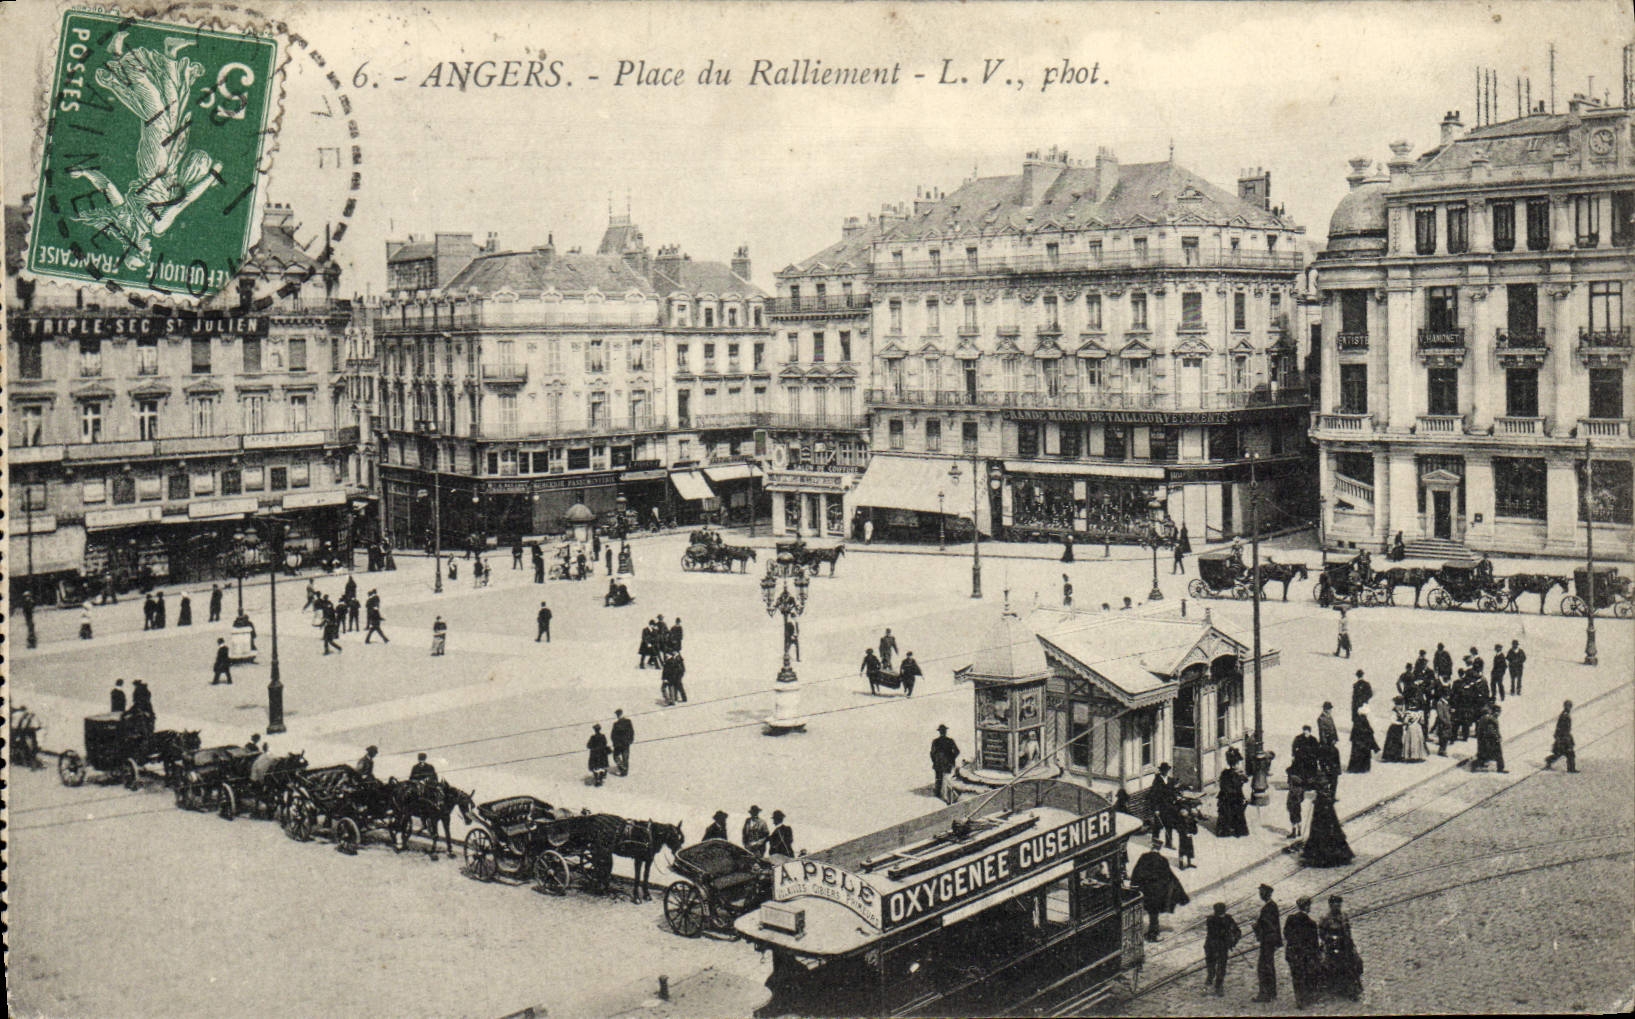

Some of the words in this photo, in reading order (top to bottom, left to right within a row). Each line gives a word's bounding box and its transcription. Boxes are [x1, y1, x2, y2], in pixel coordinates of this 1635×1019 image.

[58, 27, 91, 113] POSTES
[28, 318, 150, 335] TRIPLE-SEC
[192, 317, 258, 333] JULIEN
[1047, 410, 1089, 422] MAISON
[1091, 412, 1106, 422] DE
[1018, 811, 1110, 869] CUSENIER
[780, 863, 798, 886] A.
